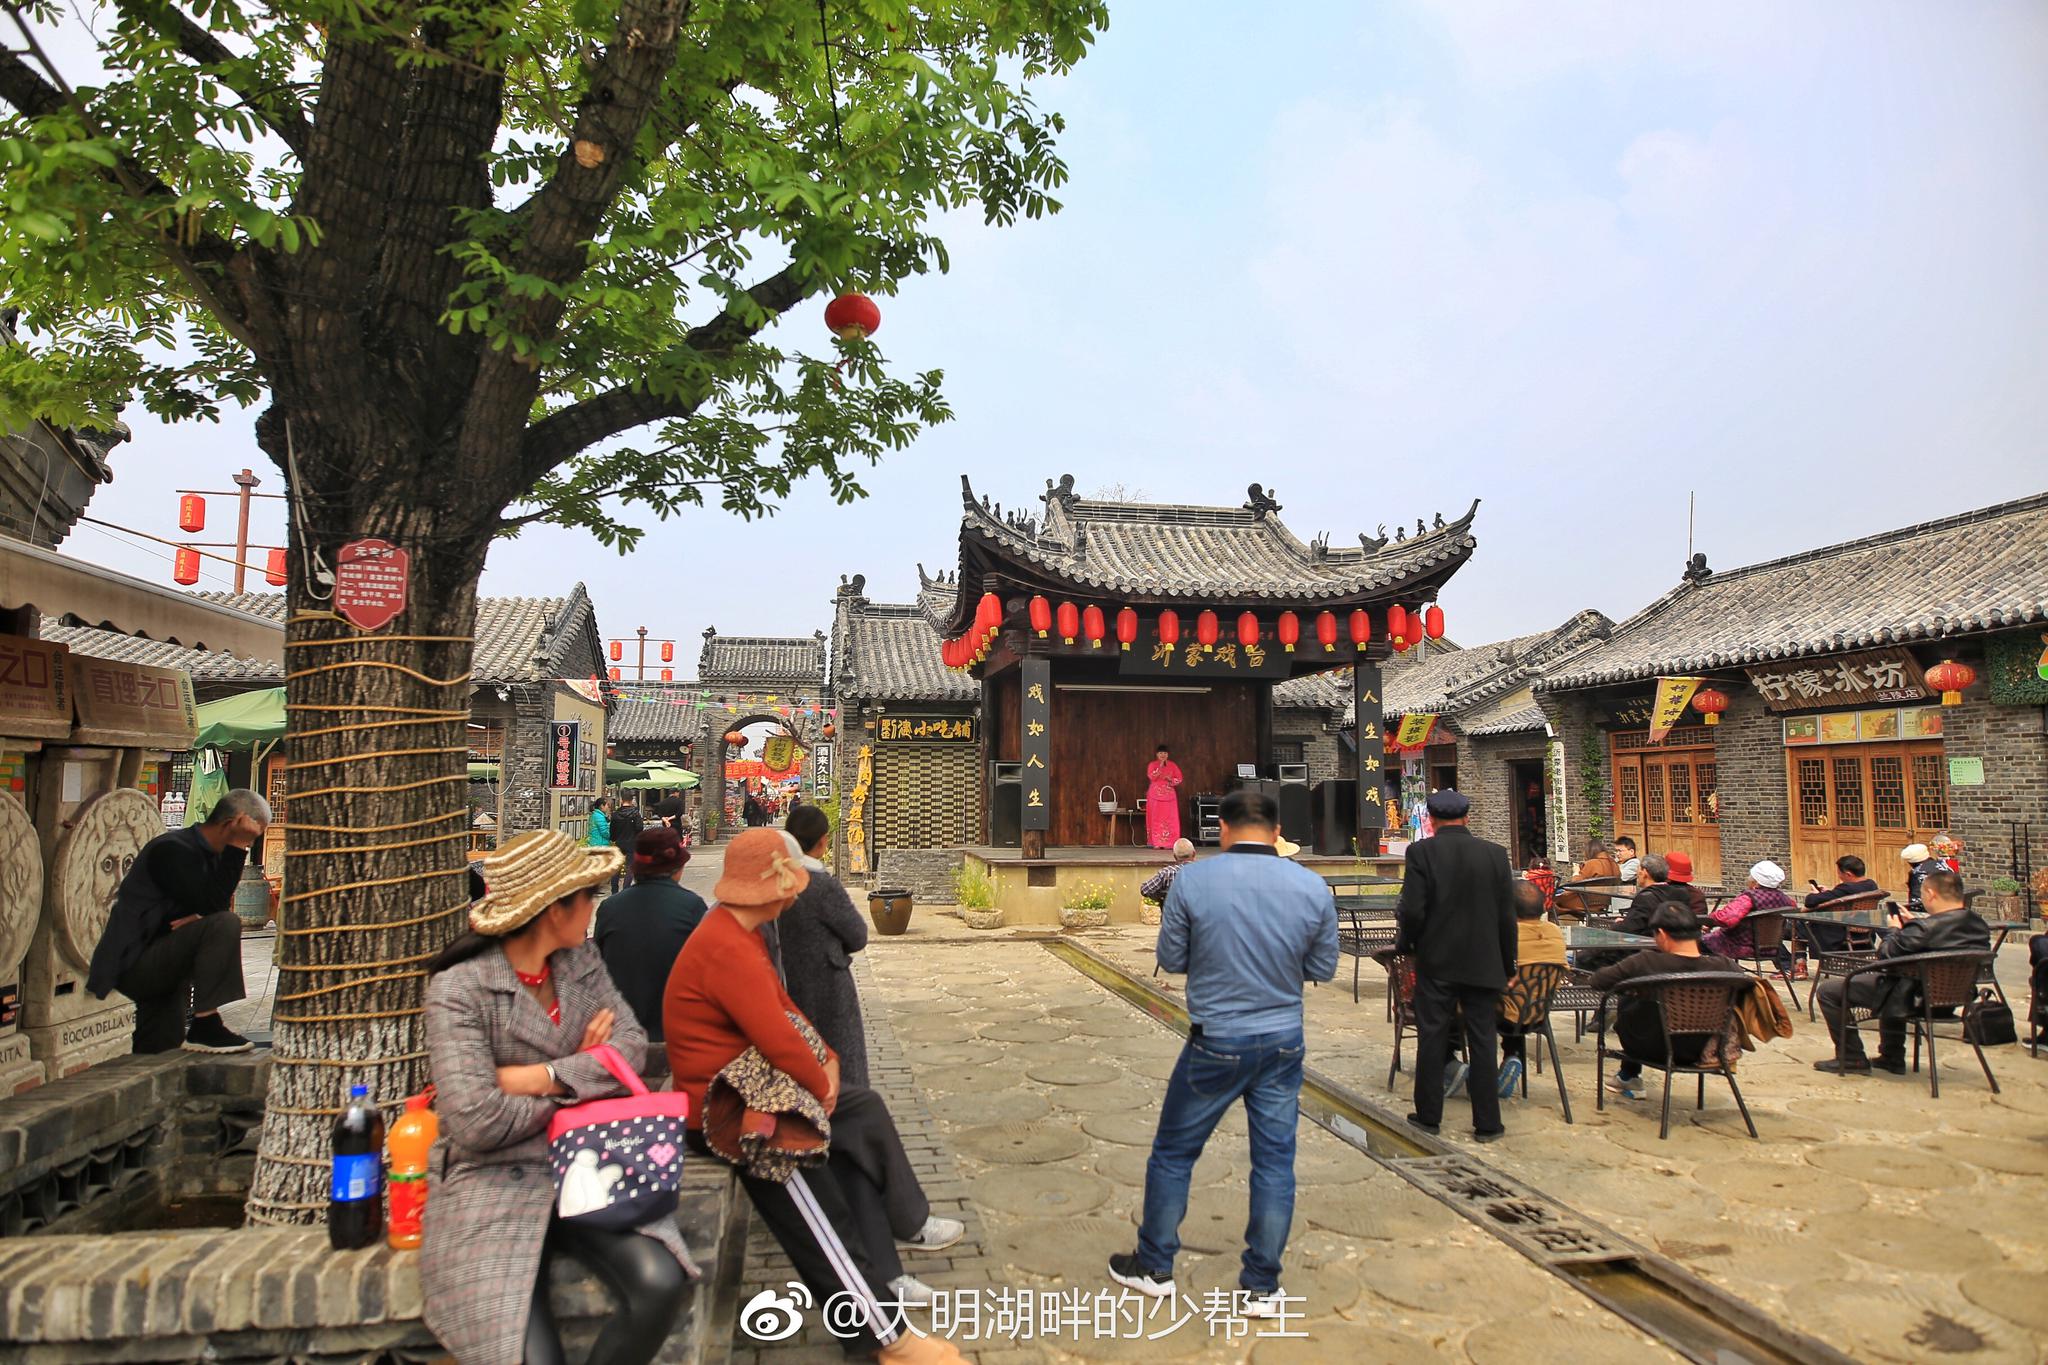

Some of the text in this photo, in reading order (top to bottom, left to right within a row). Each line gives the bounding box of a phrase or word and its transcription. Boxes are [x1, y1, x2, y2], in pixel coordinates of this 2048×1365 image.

[1152, 643, 1266, 669] 沂蒙戏台
[1752, 660, 1909, 701] 柠檬冰坊
[1026, 682, 1045, 807] 戏如人生
[1362, 689, 1381, 807] 人生如戏
[63, 1027, 95, 1046] BOCCA
[95, 1015, 125, 1036] DELLA
